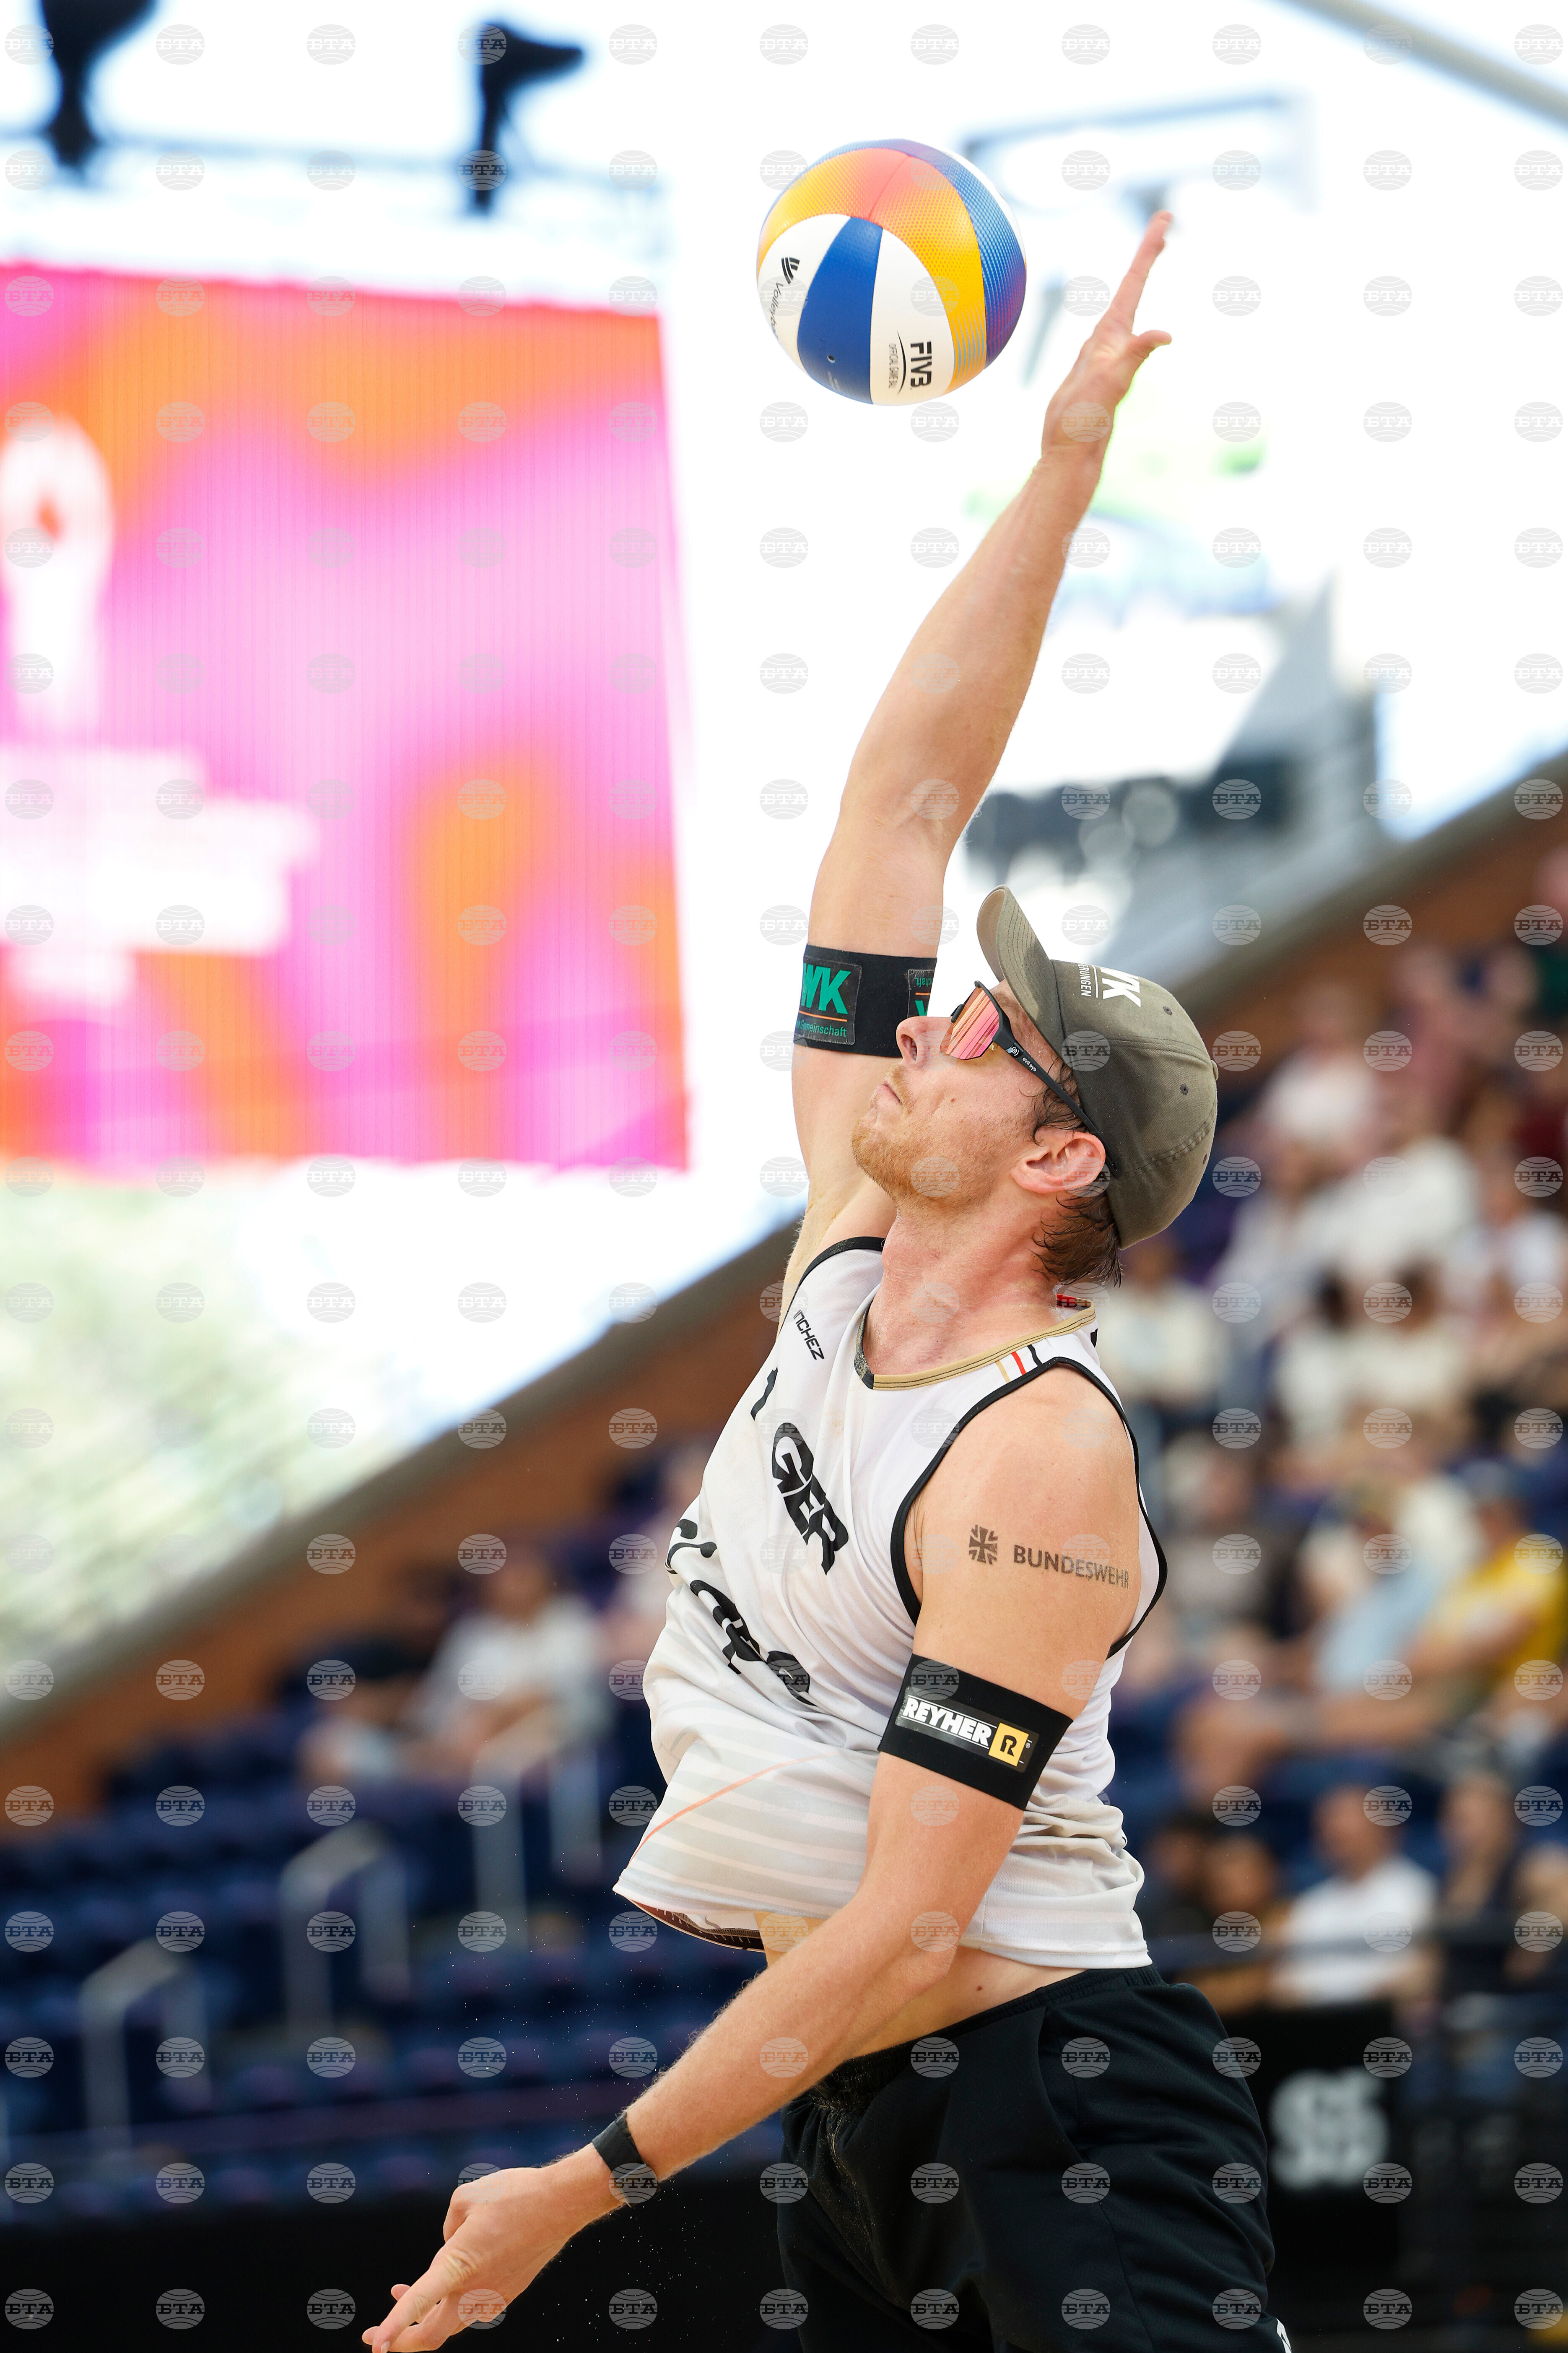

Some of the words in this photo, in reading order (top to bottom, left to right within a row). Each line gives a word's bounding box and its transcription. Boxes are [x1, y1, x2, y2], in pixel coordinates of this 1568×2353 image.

[910, 341, 932, 387] FIVB
[772, 1422, 849, 1576] GER
[1013, 1545, 1129, 1589] BUNDESWEHR
[902, 1698, 992, 1742] REYHER
